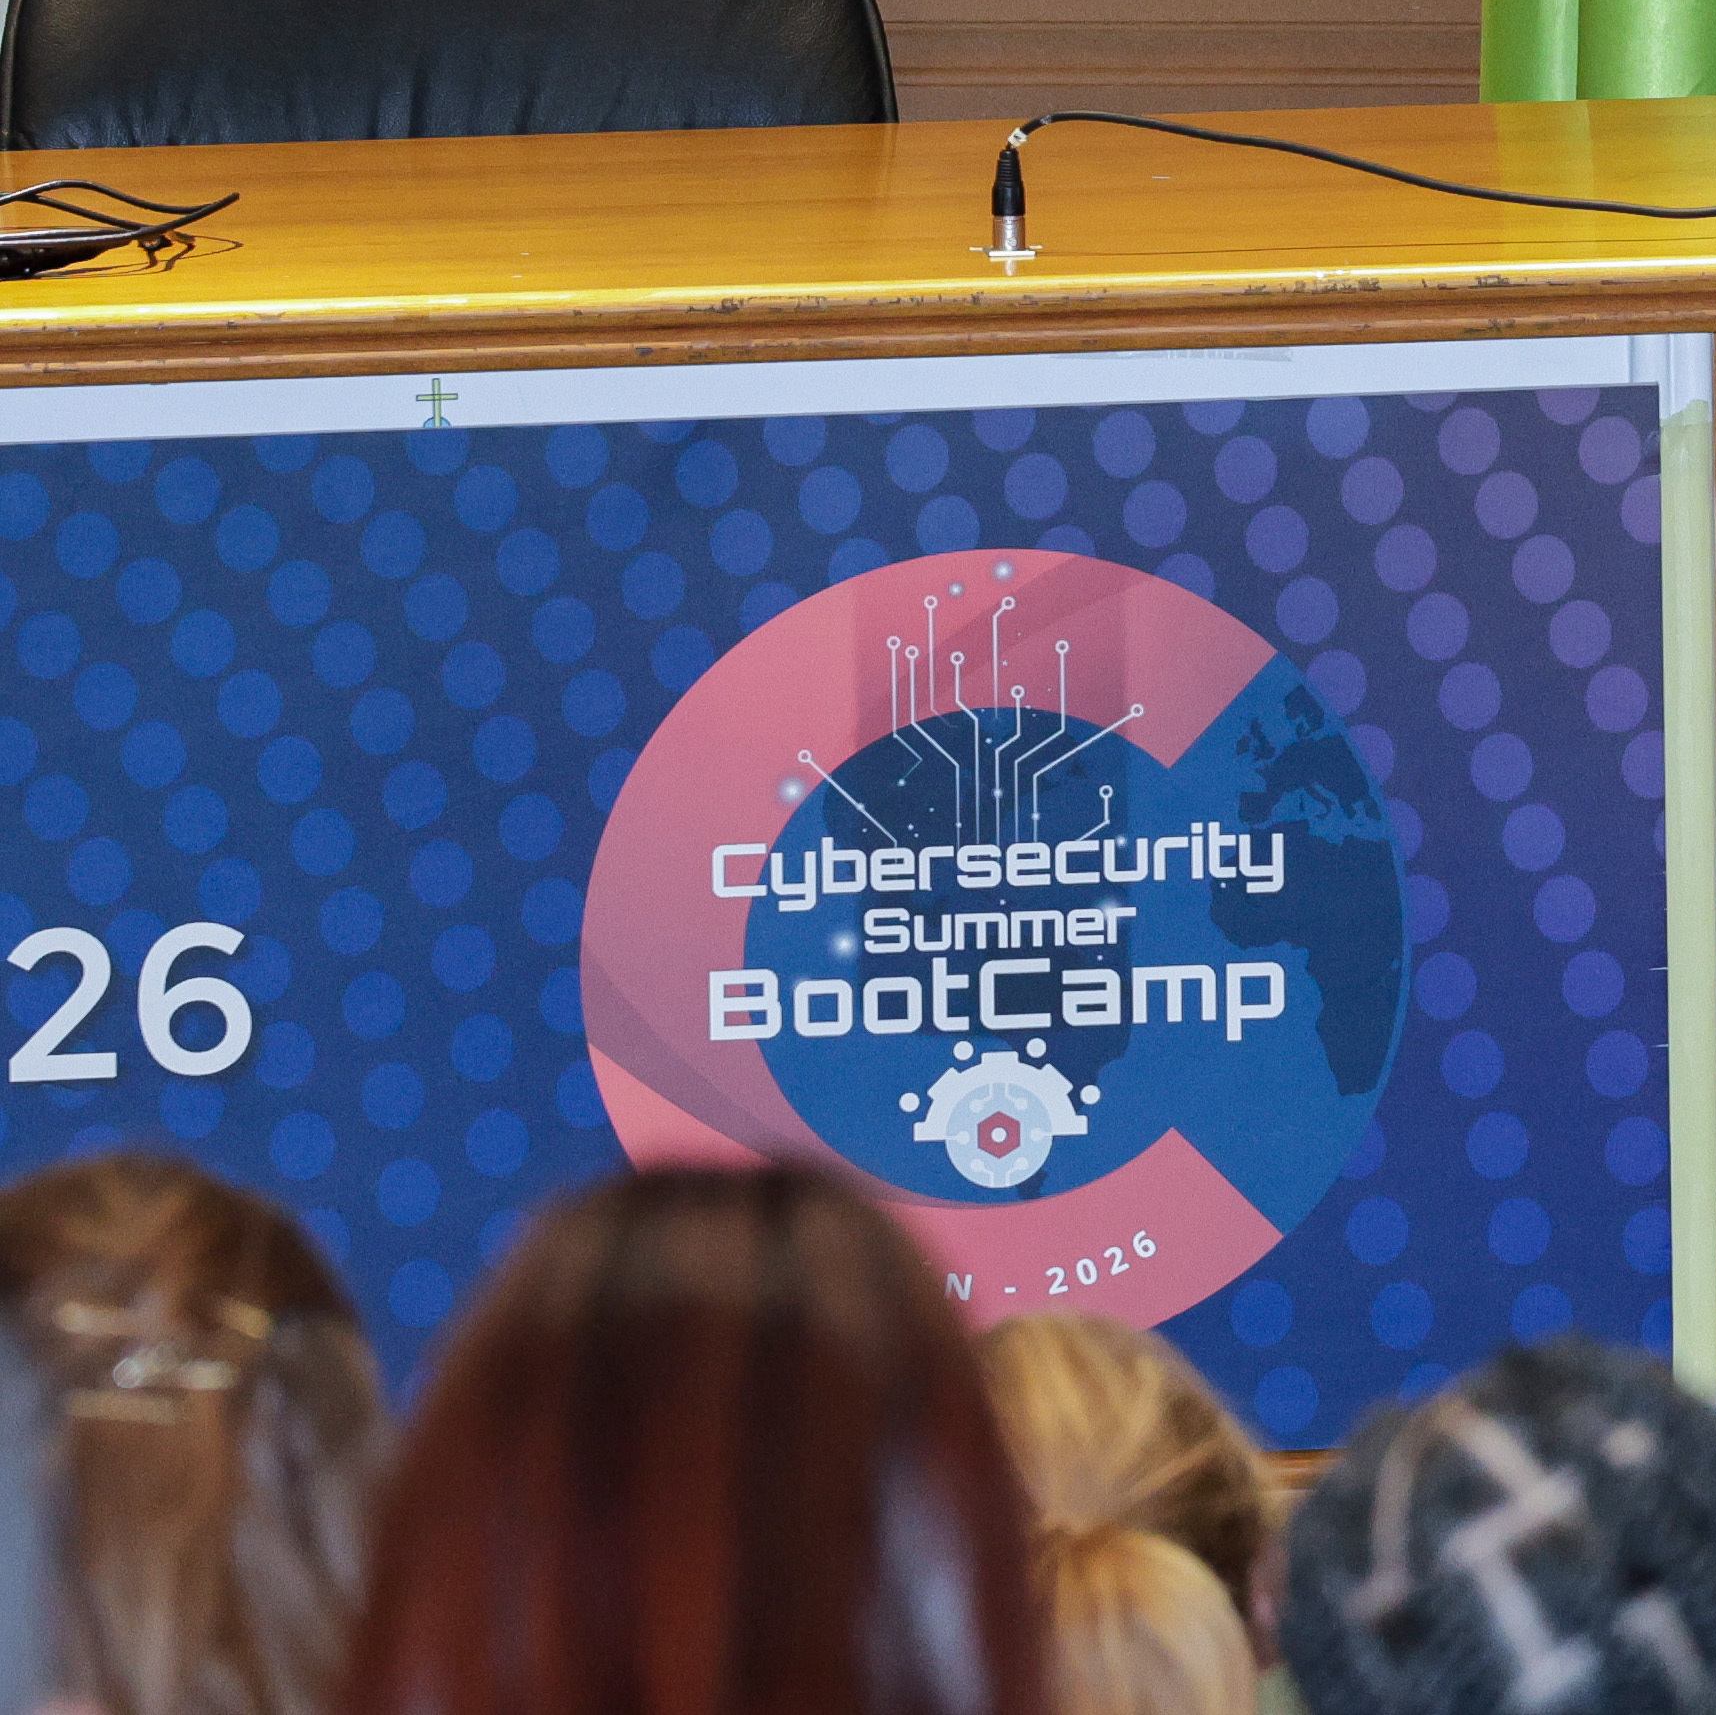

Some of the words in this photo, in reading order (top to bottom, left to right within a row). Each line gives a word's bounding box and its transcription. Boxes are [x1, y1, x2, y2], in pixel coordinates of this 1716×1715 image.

[711, 820, 1285, 913] Cybersecurity
[862, 905, 1137, 954] Summer
[708, 956, 1286, 1042] BootCamp
[1044, 1230, 1158, 1295] 2026
